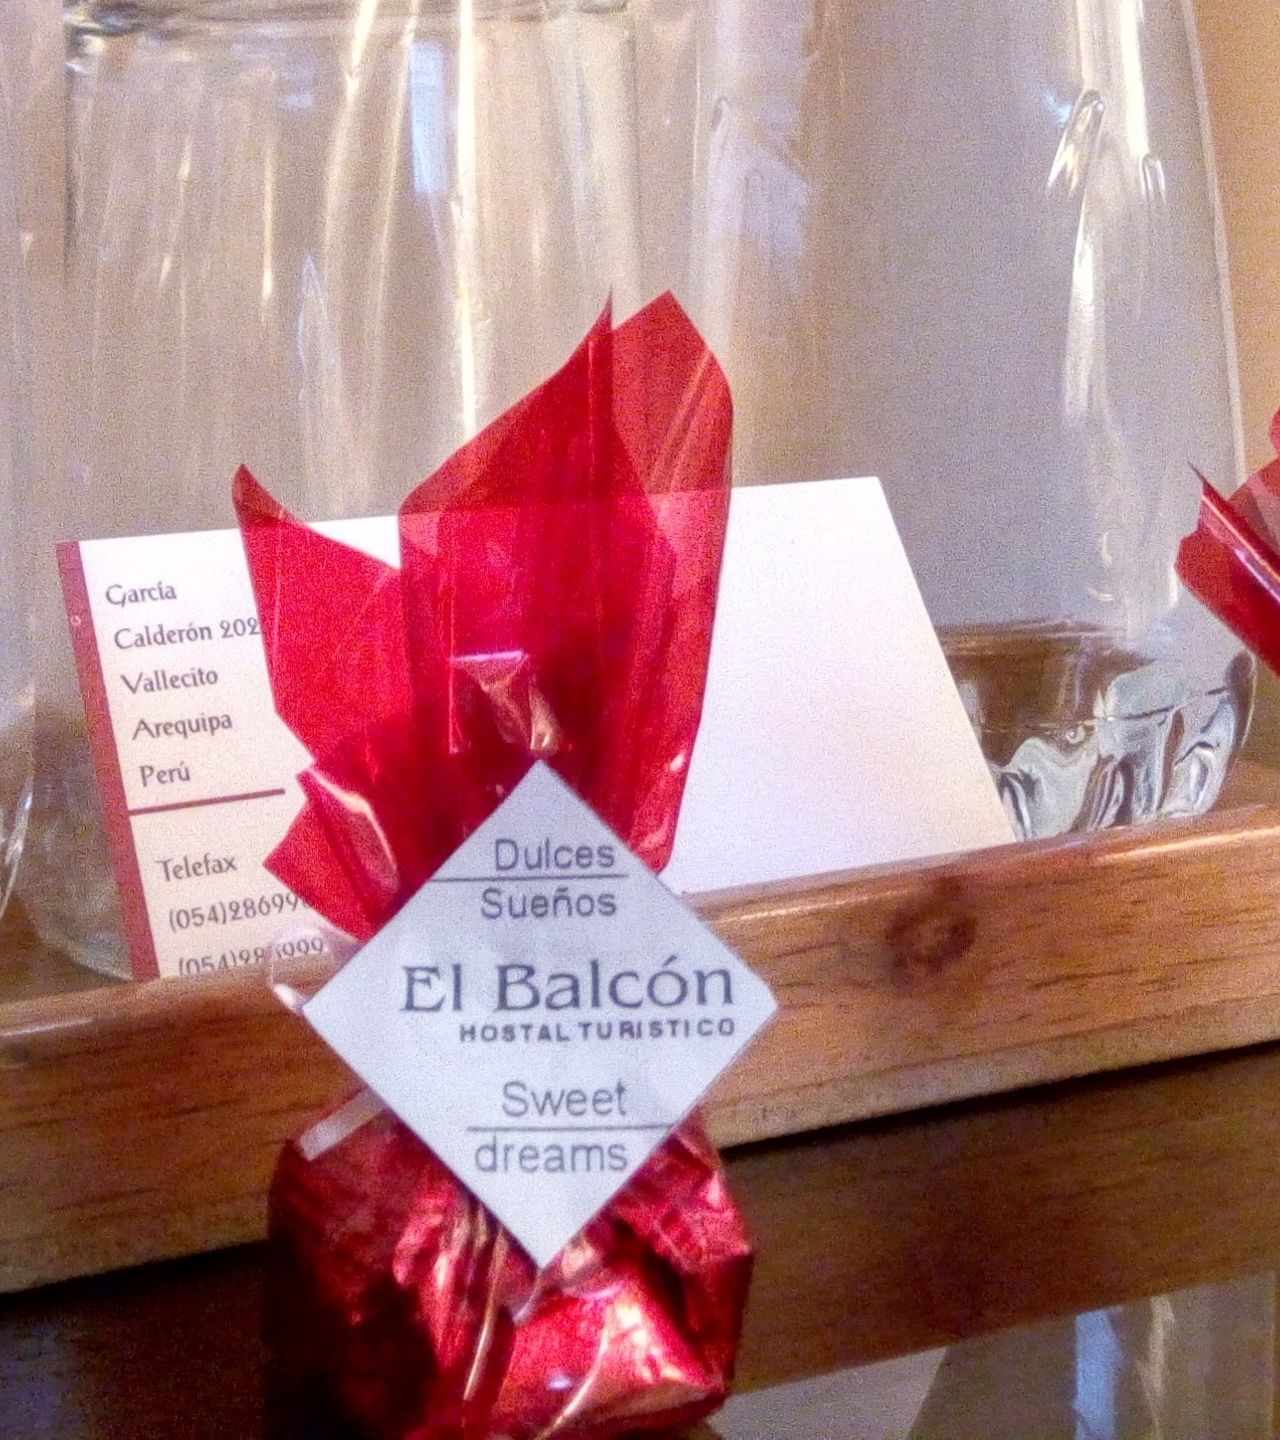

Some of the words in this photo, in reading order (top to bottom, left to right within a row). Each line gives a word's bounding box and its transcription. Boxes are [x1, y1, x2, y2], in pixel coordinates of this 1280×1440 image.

[104, 580, 179, 608] García
[114, 621, 214, 650] Calderón
[218, 615, 262, 640] 202
[120, 666, 220, 697] Vallecito
[131, 712, 234, 741] Arequipa
[139, 761, 193, 789] Perú
[156, 851, 239, 883] Telefax
[493, 836, 617, 873] Dulces
[168, 891, 310, 933] (054)28699
[479, 885, 619, 920] Sueños
[399, 962, 464, 1014] El
[494, 954, 735, 1013] Balcón
[459, 1021, 572, 1043] HOSTAL
[577, 1017, 737, 1042] TURISTICO
[500, 1078, 630, 1118] Sweet
[473, 1135, 630, 1175] dreams
